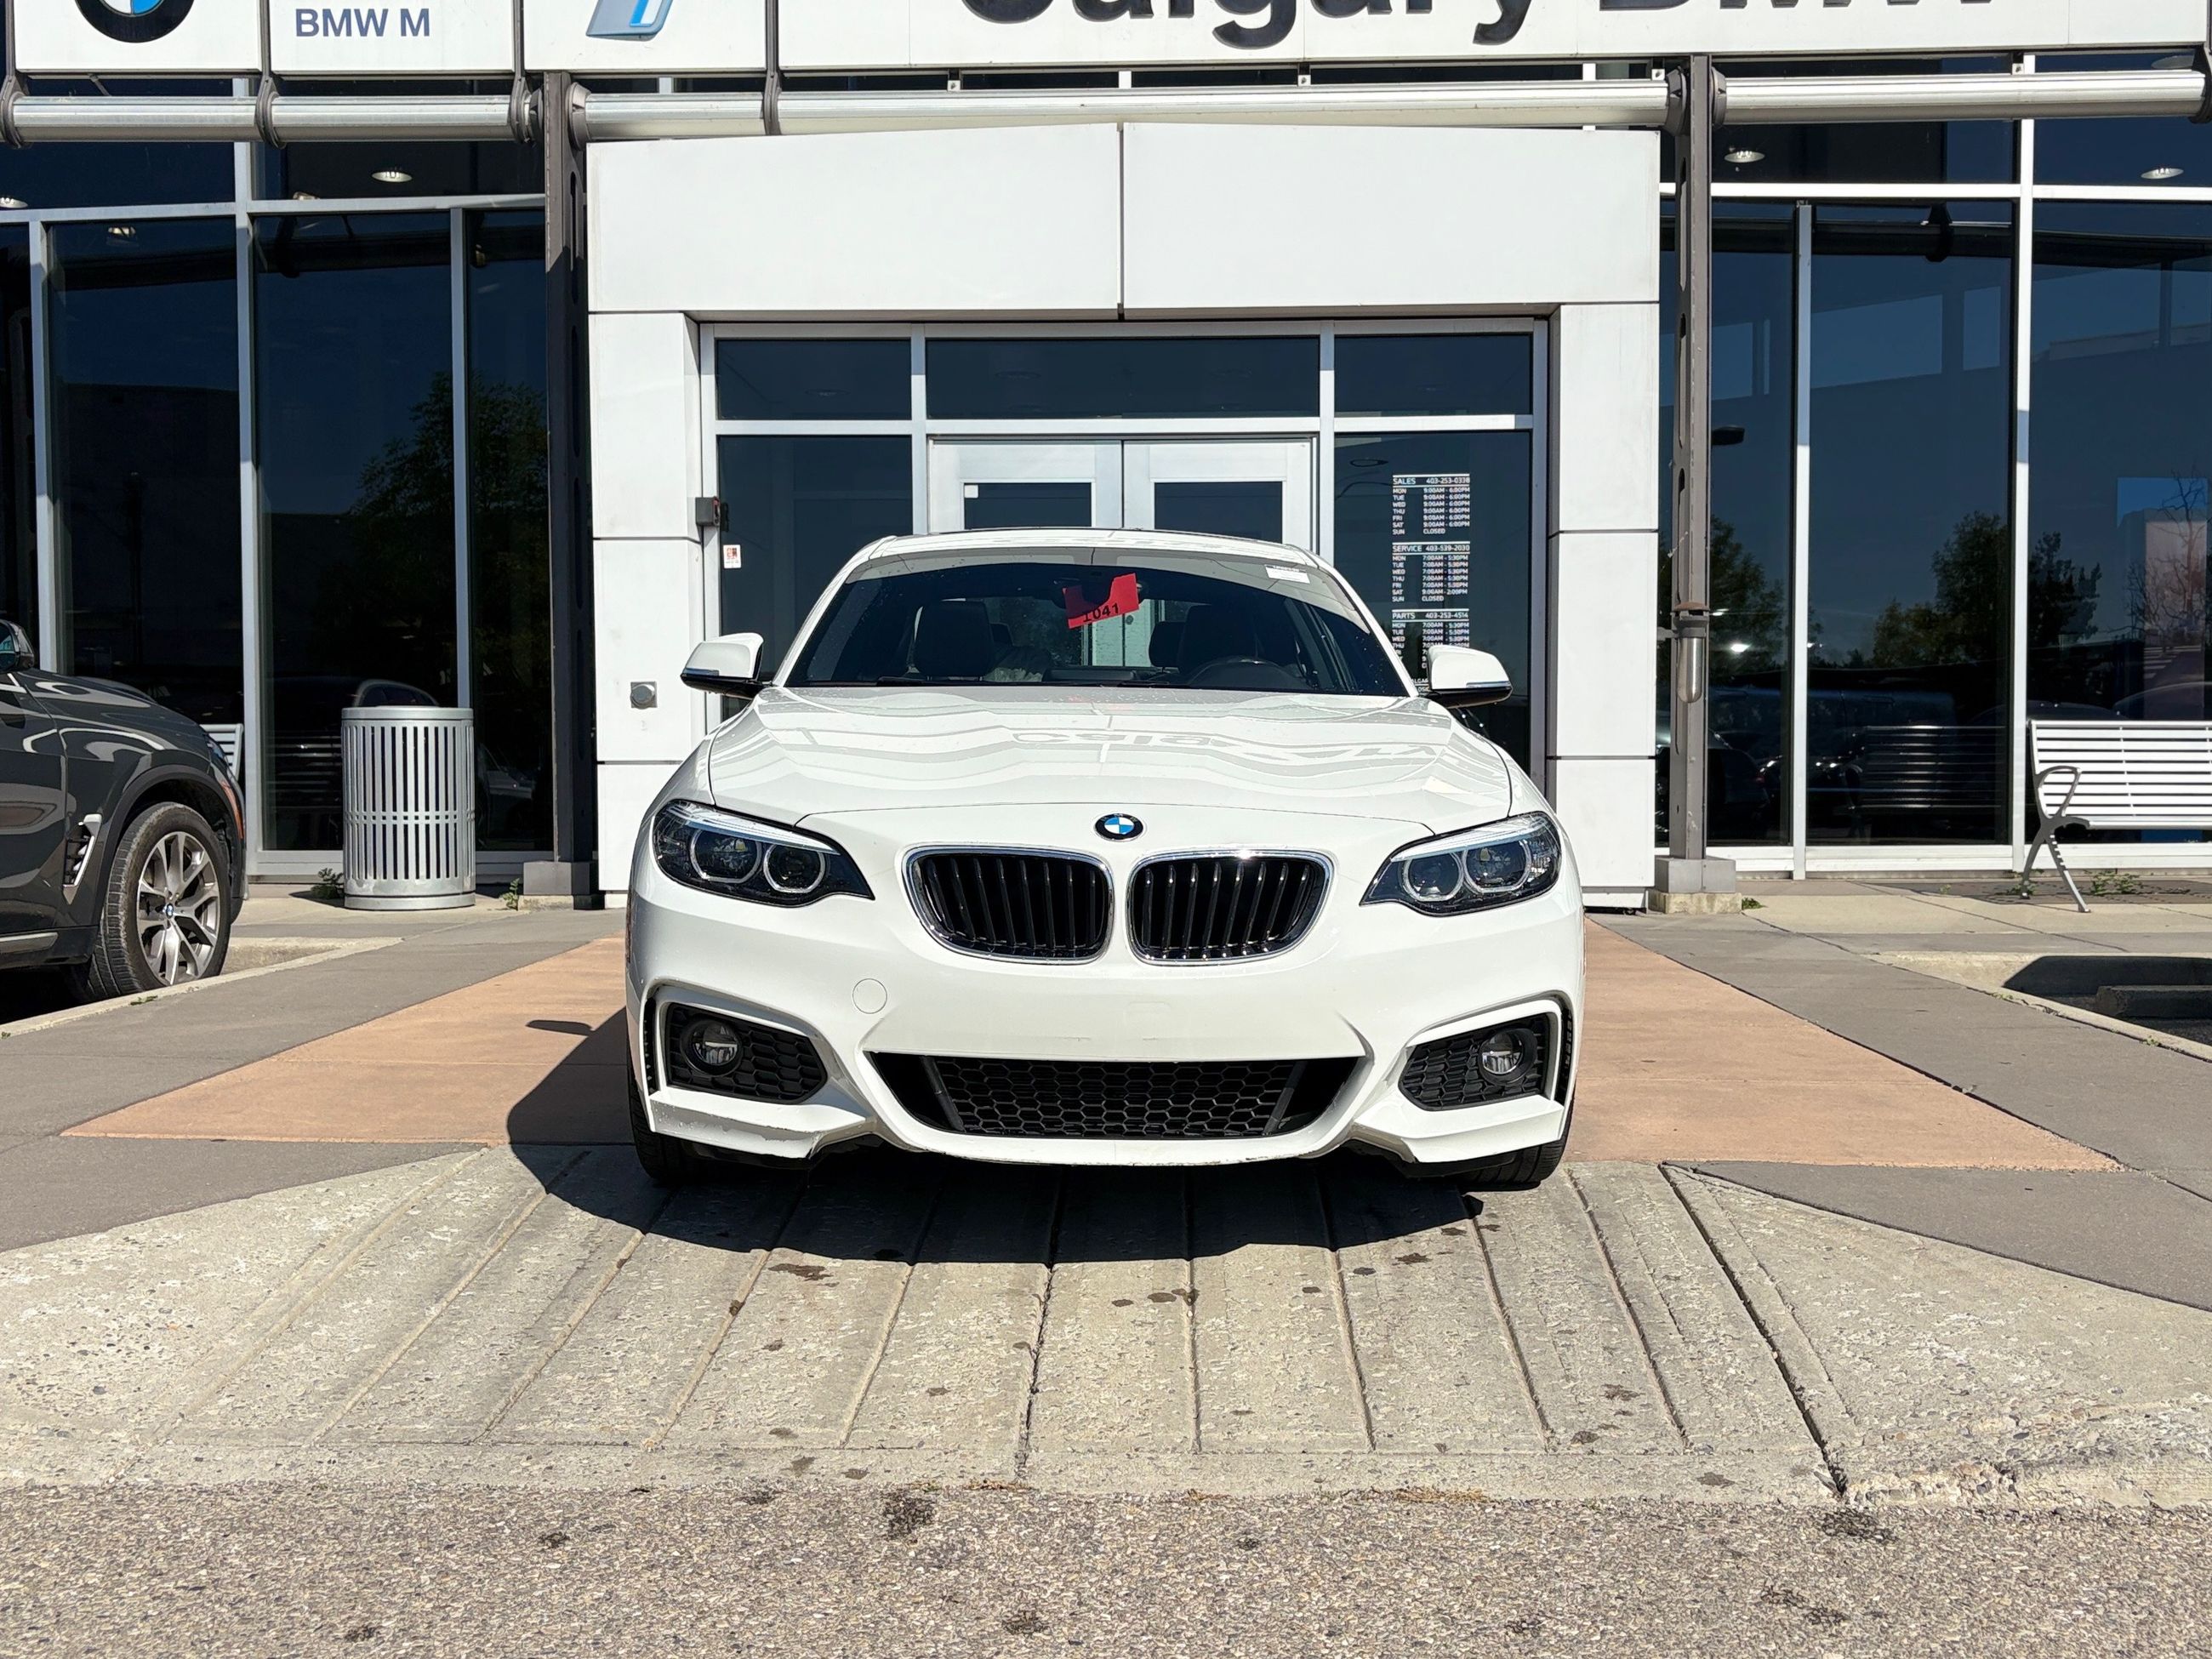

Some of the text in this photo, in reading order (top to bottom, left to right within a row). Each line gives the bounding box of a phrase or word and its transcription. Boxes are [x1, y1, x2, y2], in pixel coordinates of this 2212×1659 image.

[295, 8, 430, 37] BMW M
[1083, 602, 1119, 622] 1041
